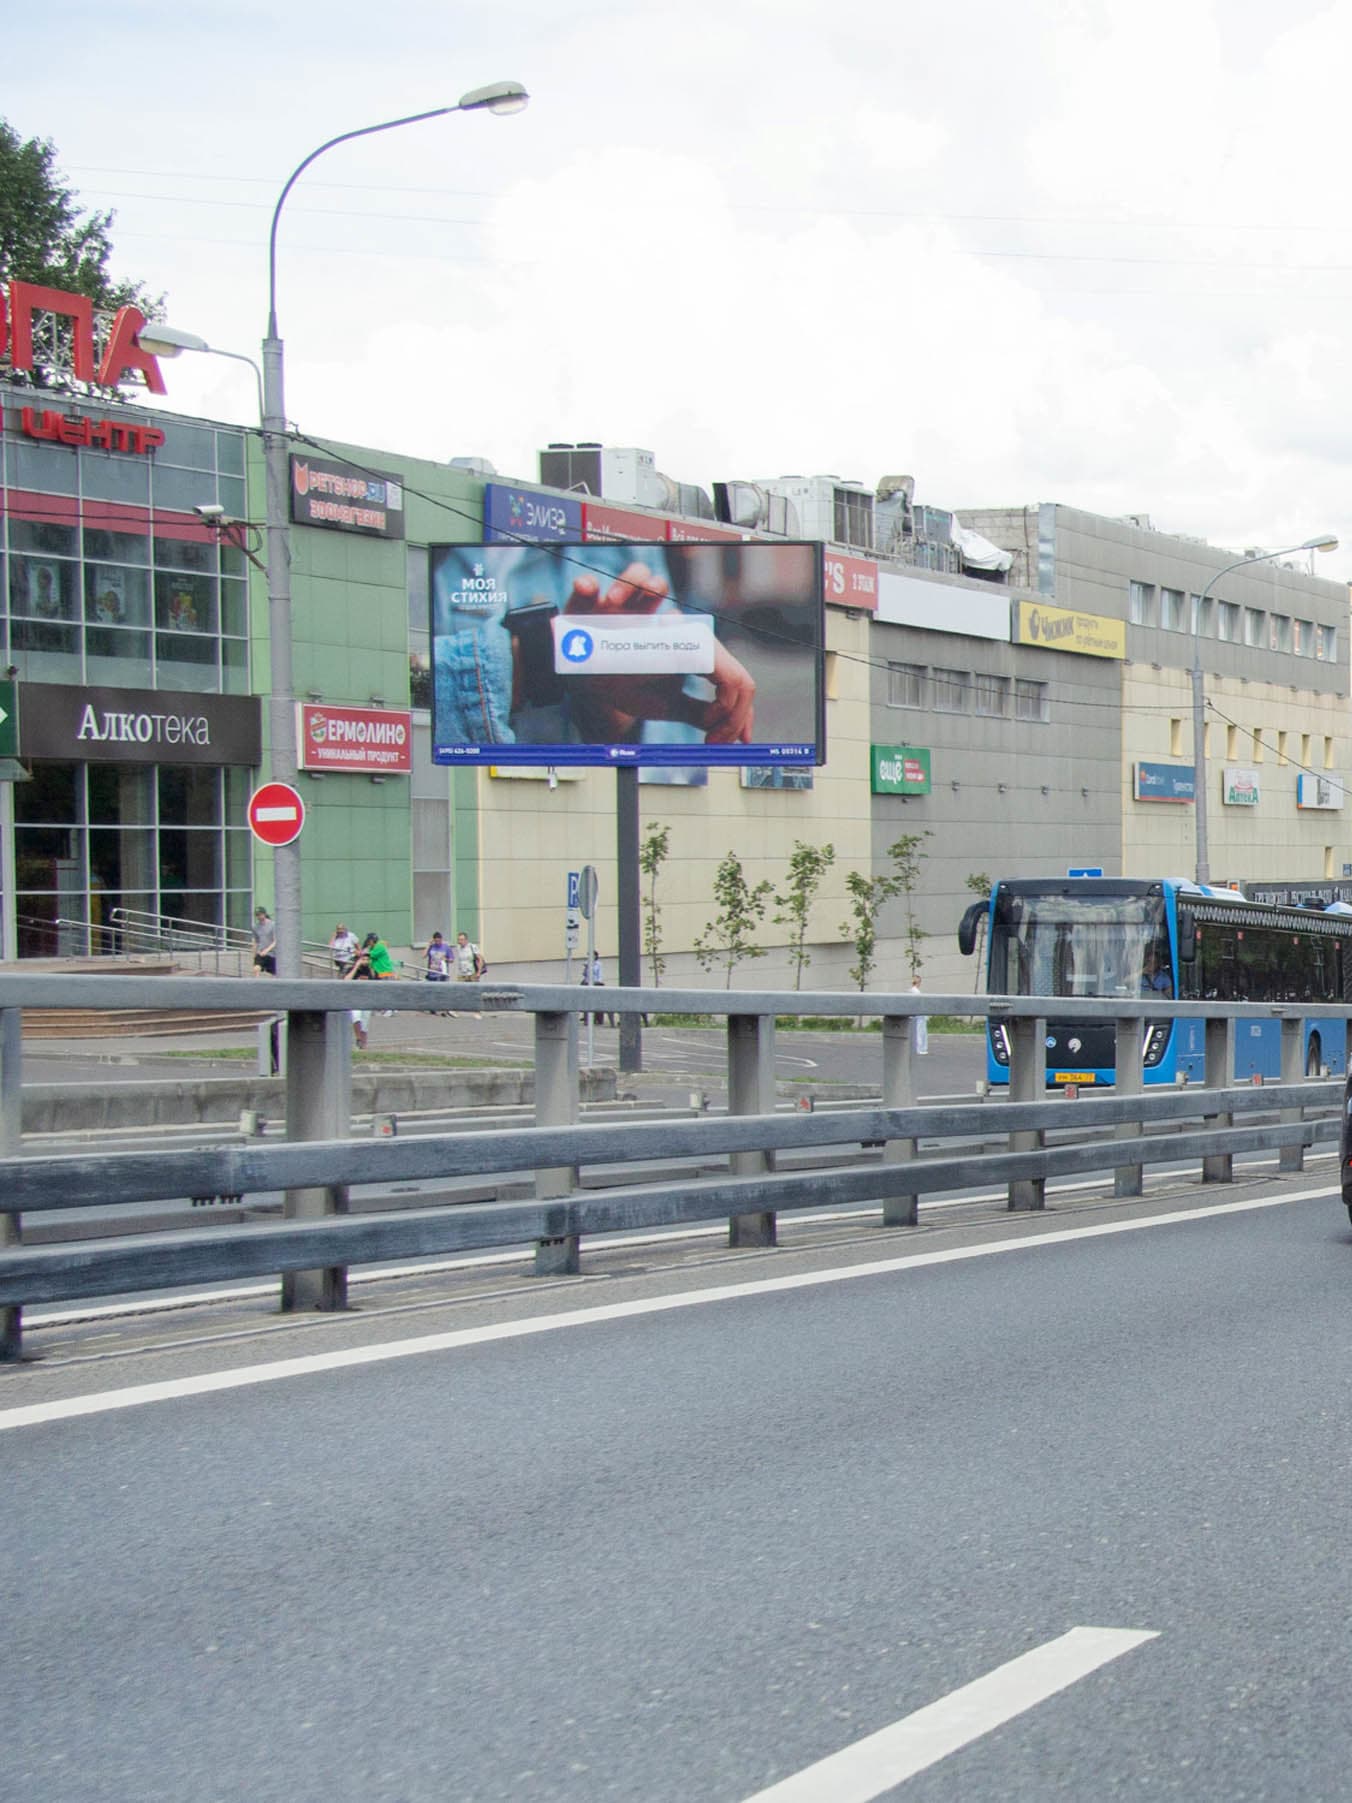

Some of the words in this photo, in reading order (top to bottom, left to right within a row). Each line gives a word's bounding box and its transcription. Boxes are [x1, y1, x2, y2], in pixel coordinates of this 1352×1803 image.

[0, 281, 168, 395] ПА
[21, 405, 166, 455] ЦЕНТР
[461, 578, 496, 590] МОЯ
[451, 591, 508, 603] СТИХИЯ
[600, 640, 631, 652] Пора
[633, 641, 671, 651] выпить
[673, 641, 701, 652] воды
[328, 719, 406, 745] ЕРМОЛИНО
[367, 750, 401, 764] ПРОДУКТ
